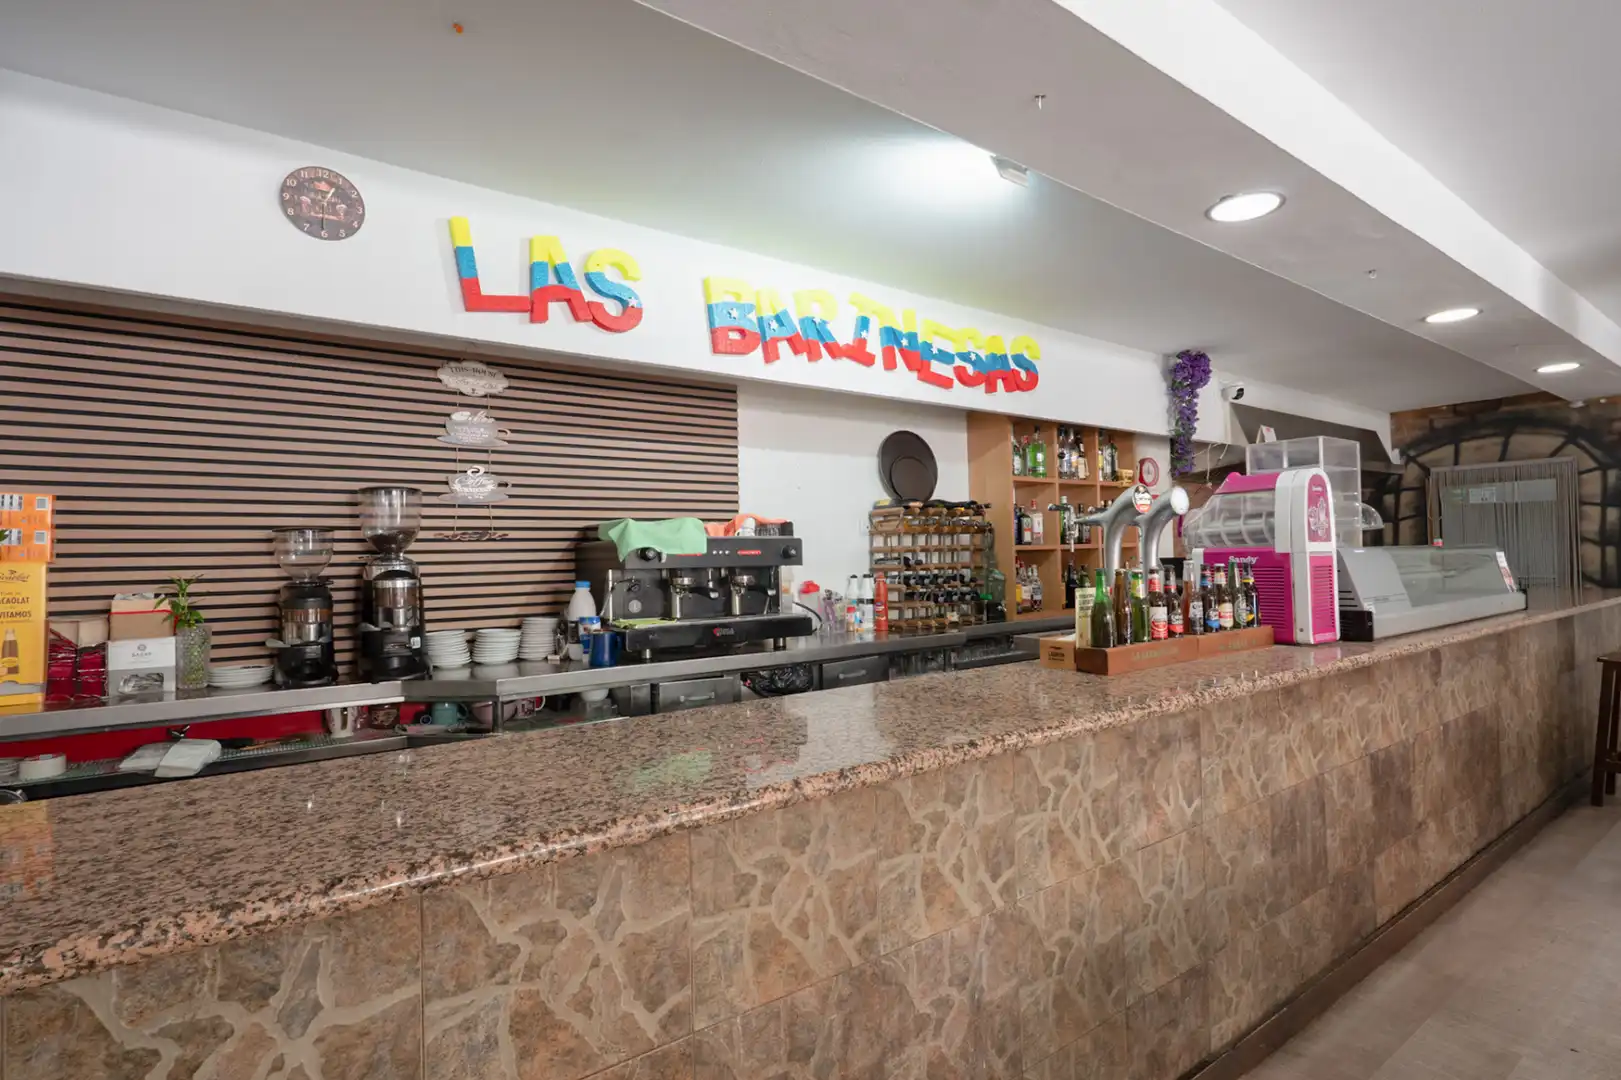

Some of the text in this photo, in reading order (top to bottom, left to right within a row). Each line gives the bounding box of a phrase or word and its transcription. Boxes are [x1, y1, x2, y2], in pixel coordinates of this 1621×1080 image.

[300, 170, 308, 178] 11
[317, 168, 329, 178] 12
[286, 179, 297, 187] 10
[283, 192, 289, 200] 9
[351, 190, 358, 198] 2
[303, 223, 310, 231] 7
[321, 230, 328, 238] 6
[339, 229, 345, 237] 5
[448, 216, 1042, 394] LAS BARINESAS
[1228, 555, 1258, 564] Sandy
